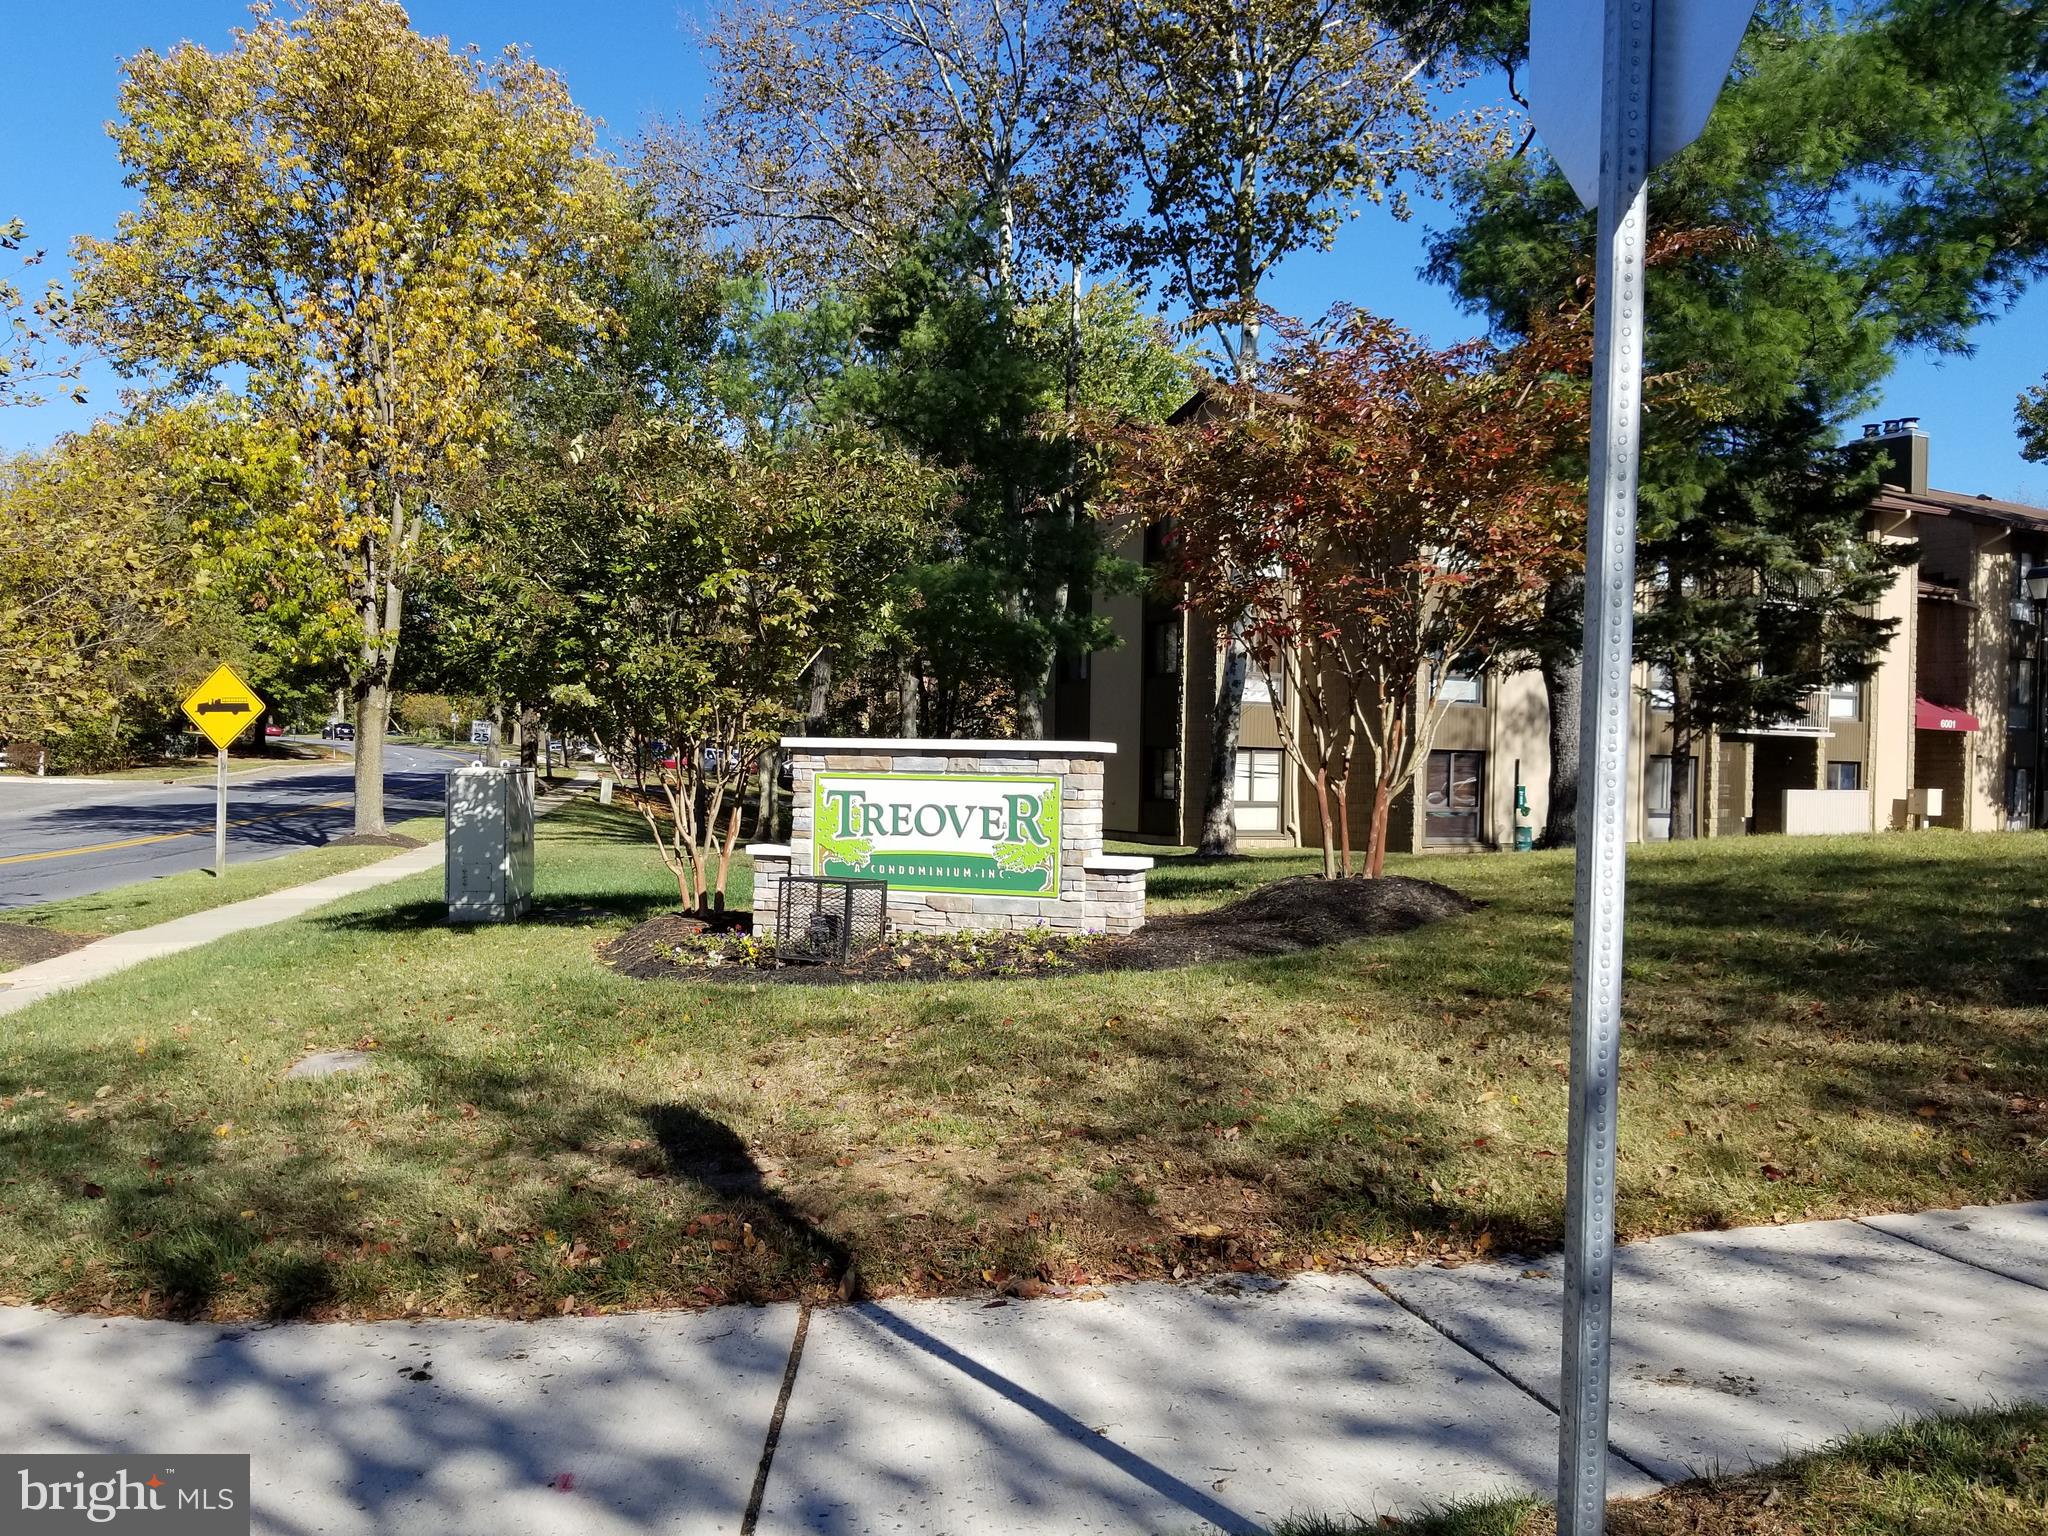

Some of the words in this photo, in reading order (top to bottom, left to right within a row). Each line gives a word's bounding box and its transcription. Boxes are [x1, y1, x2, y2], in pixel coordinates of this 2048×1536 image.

[1940, 719, 1956, 729] 6001
[473, 732, 489, 742] 25
[827, 790, 1049, 846] TREOVER
[854, 864, 861, 873] A
